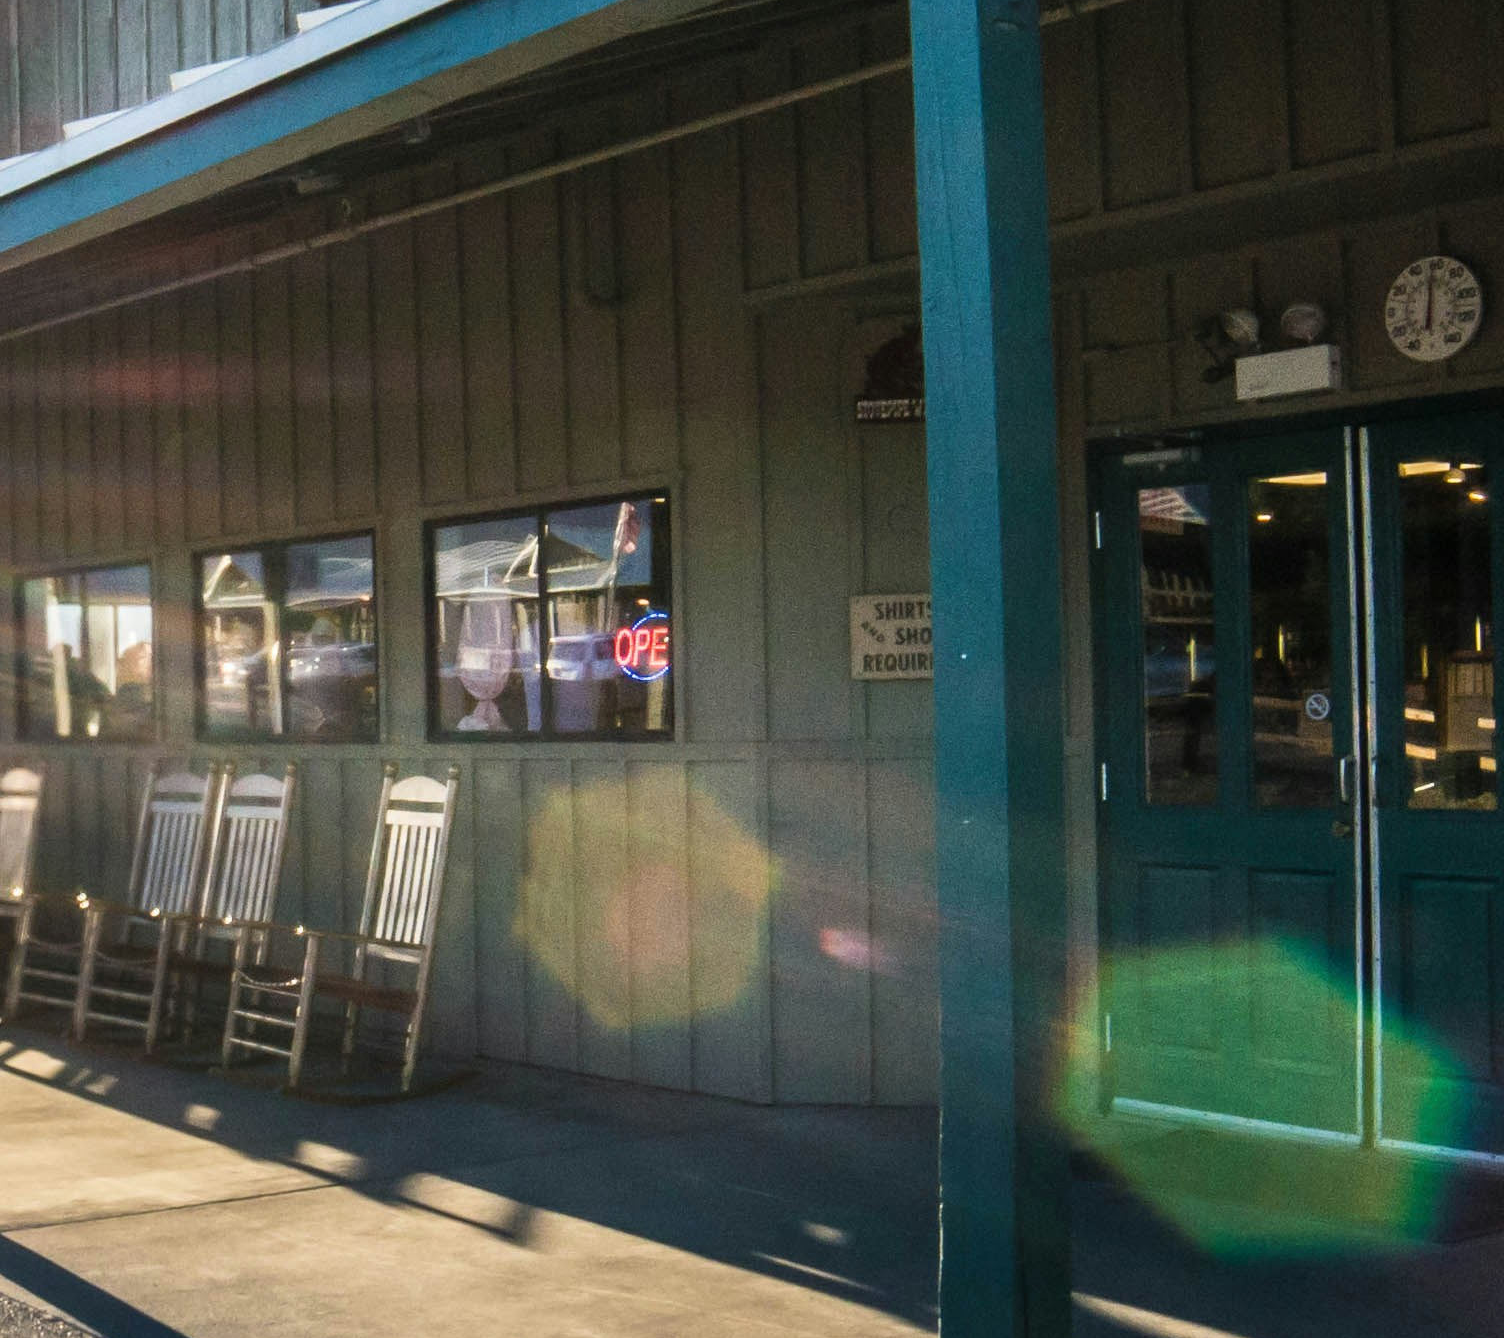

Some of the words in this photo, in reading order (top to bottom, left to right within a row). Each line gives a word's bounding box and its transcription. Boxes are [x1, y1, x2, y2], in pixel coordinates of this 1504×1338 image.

[895, 627, 932, 646] SHO
[614, 626, 669, 667] OPE
[863, 653, 933, 672] REQUIR
